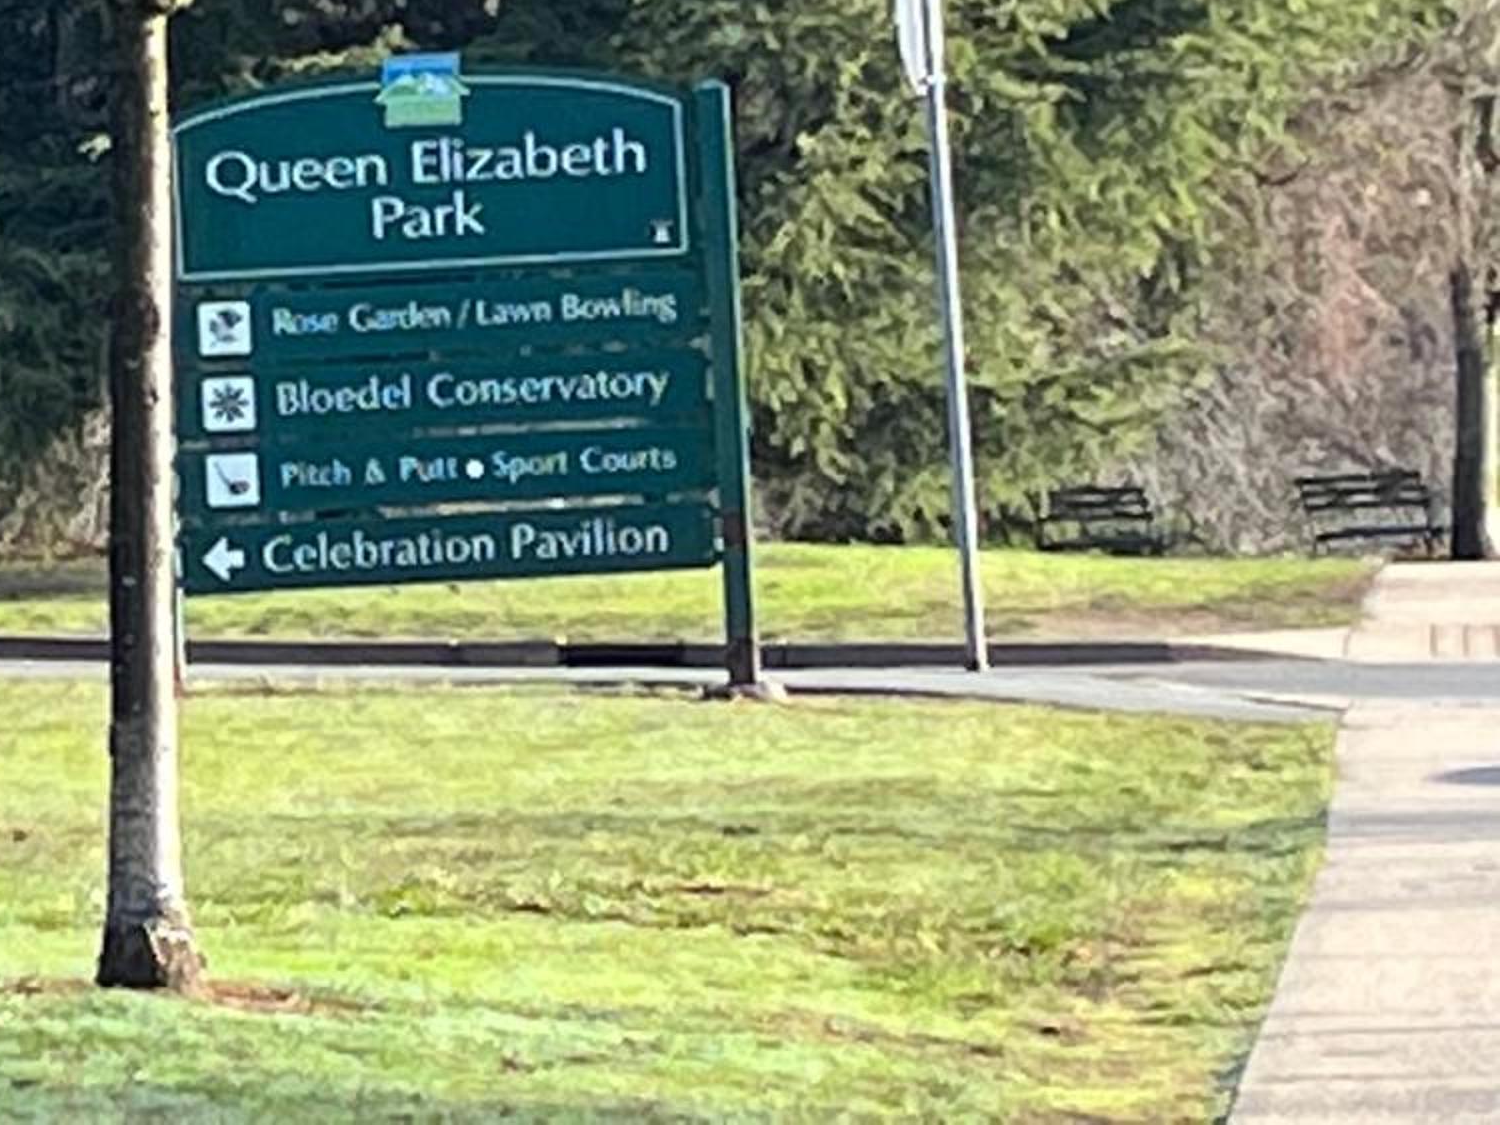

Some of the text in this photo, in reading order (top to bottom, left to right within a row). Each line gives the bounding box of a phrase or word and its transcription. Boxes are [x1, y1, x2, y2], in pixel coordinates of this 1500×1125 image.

[206, 128, 646, 203] Queen Elizabeth
[372, 191, 485, 239] Park
[272, 307, 338, 335] Rose
[349, 300, 451, 332] Garden
[476, 299, 551, 327] Lawn
[562, 289, 677, 323] Bowling
[276, 369, 669, 415] Bloedel Conservatory
[280, 459, 352, 488] Pitch
[400, 455, 458, 483] Putt
[492, 451, 568, 483] Sport
[579, 445, 677, 473] Courts
[262, 518, 669, 574] Celebration Pavilion
